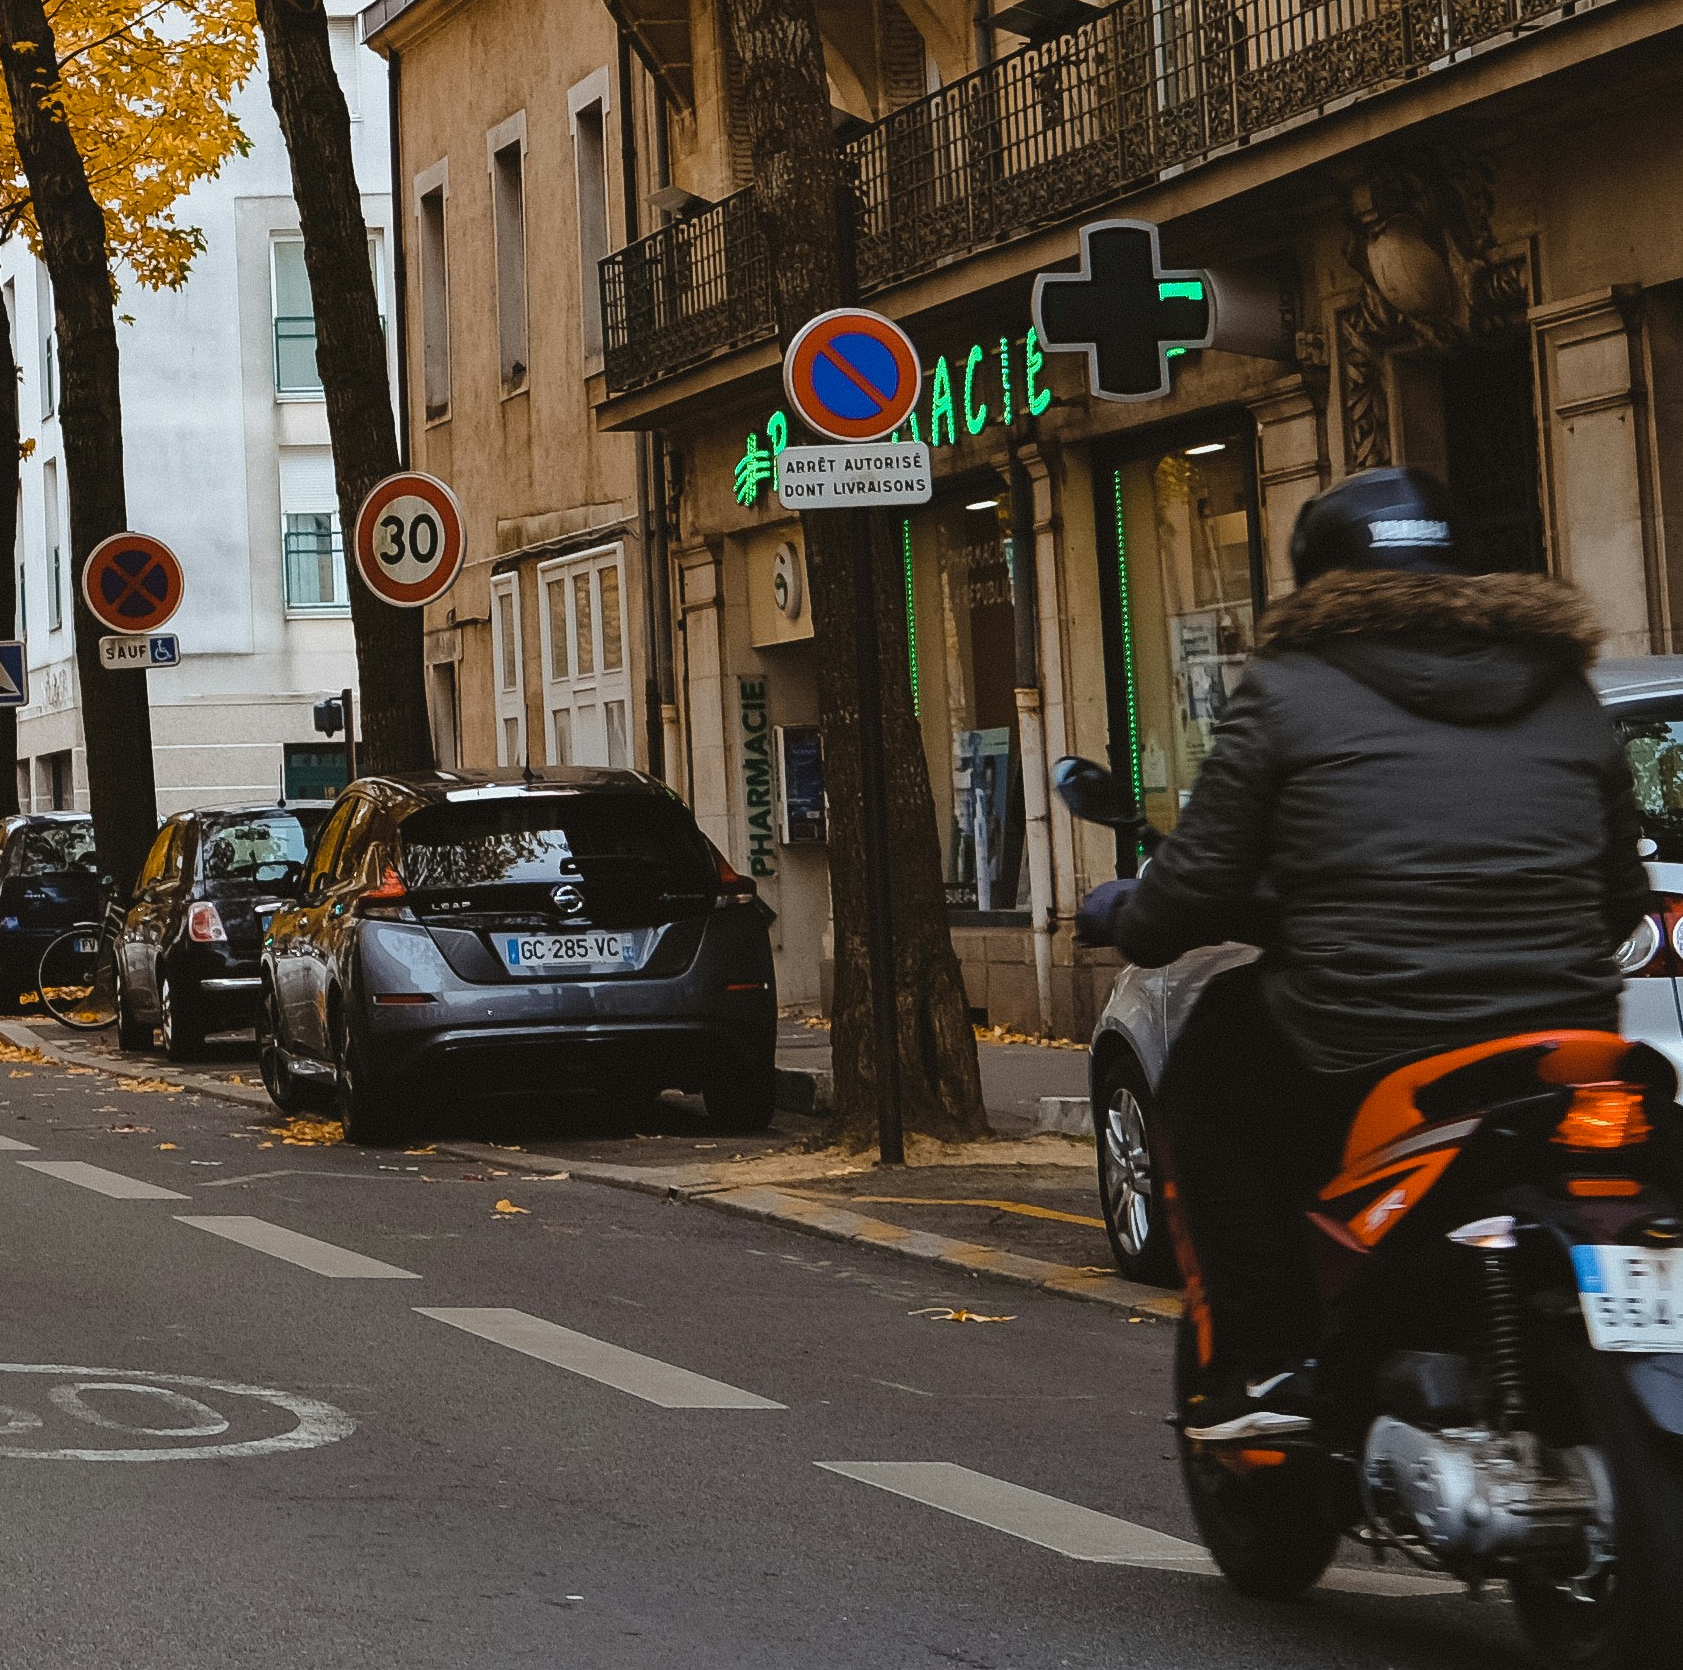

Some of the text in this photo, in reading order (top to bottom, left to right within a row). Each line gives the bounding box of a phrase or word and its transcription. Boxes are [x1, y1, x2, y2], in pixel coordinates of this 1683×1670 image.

[767, 325, 1050, 492] PACIE
[786, 452, 923, 474] ARRÊT AUTORISÉ
[785, 478, 926, 498] DONT LIVRAISONS
[380, 513, 439, 565] 30
[105, 644, 147, 661] SAUF
[740, 681, 776, 878] PHARMACIE
[520, 936, 620, 961] GC-285-VC
